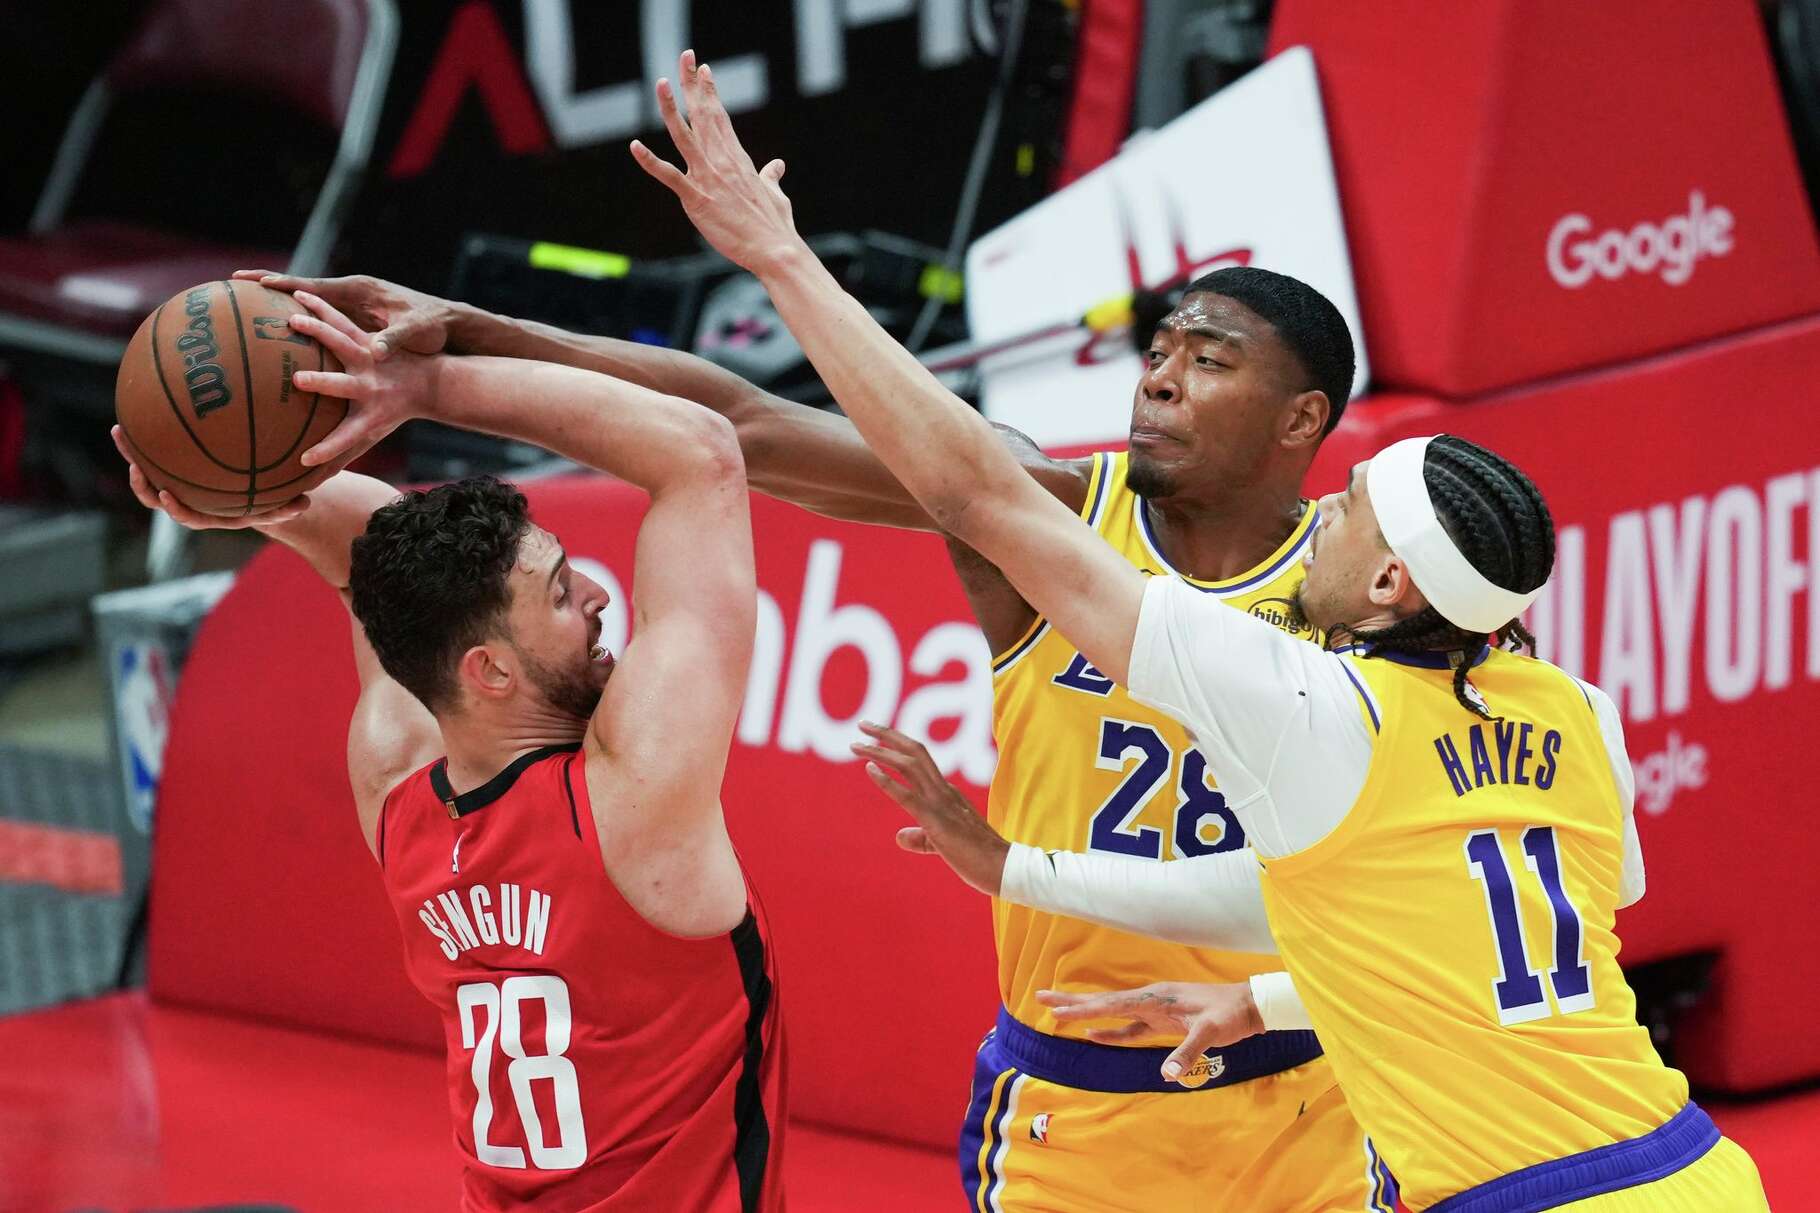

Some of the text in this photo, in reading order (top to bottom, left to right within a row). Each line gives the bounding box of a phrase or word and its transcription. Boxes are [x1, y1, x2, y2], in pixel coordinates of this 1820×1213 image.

[1547, 188, 1734, 288] Google
[176, 286, 233, 421] Wilson
[1088, 716, 1248, 862] 28
[1433, 721, 1562, 797] HAYES
[418, 883, 551, 962] SENGUN
[1463, 825, 1596, 1027] 11
[456, 975, 588, 1170] 28
